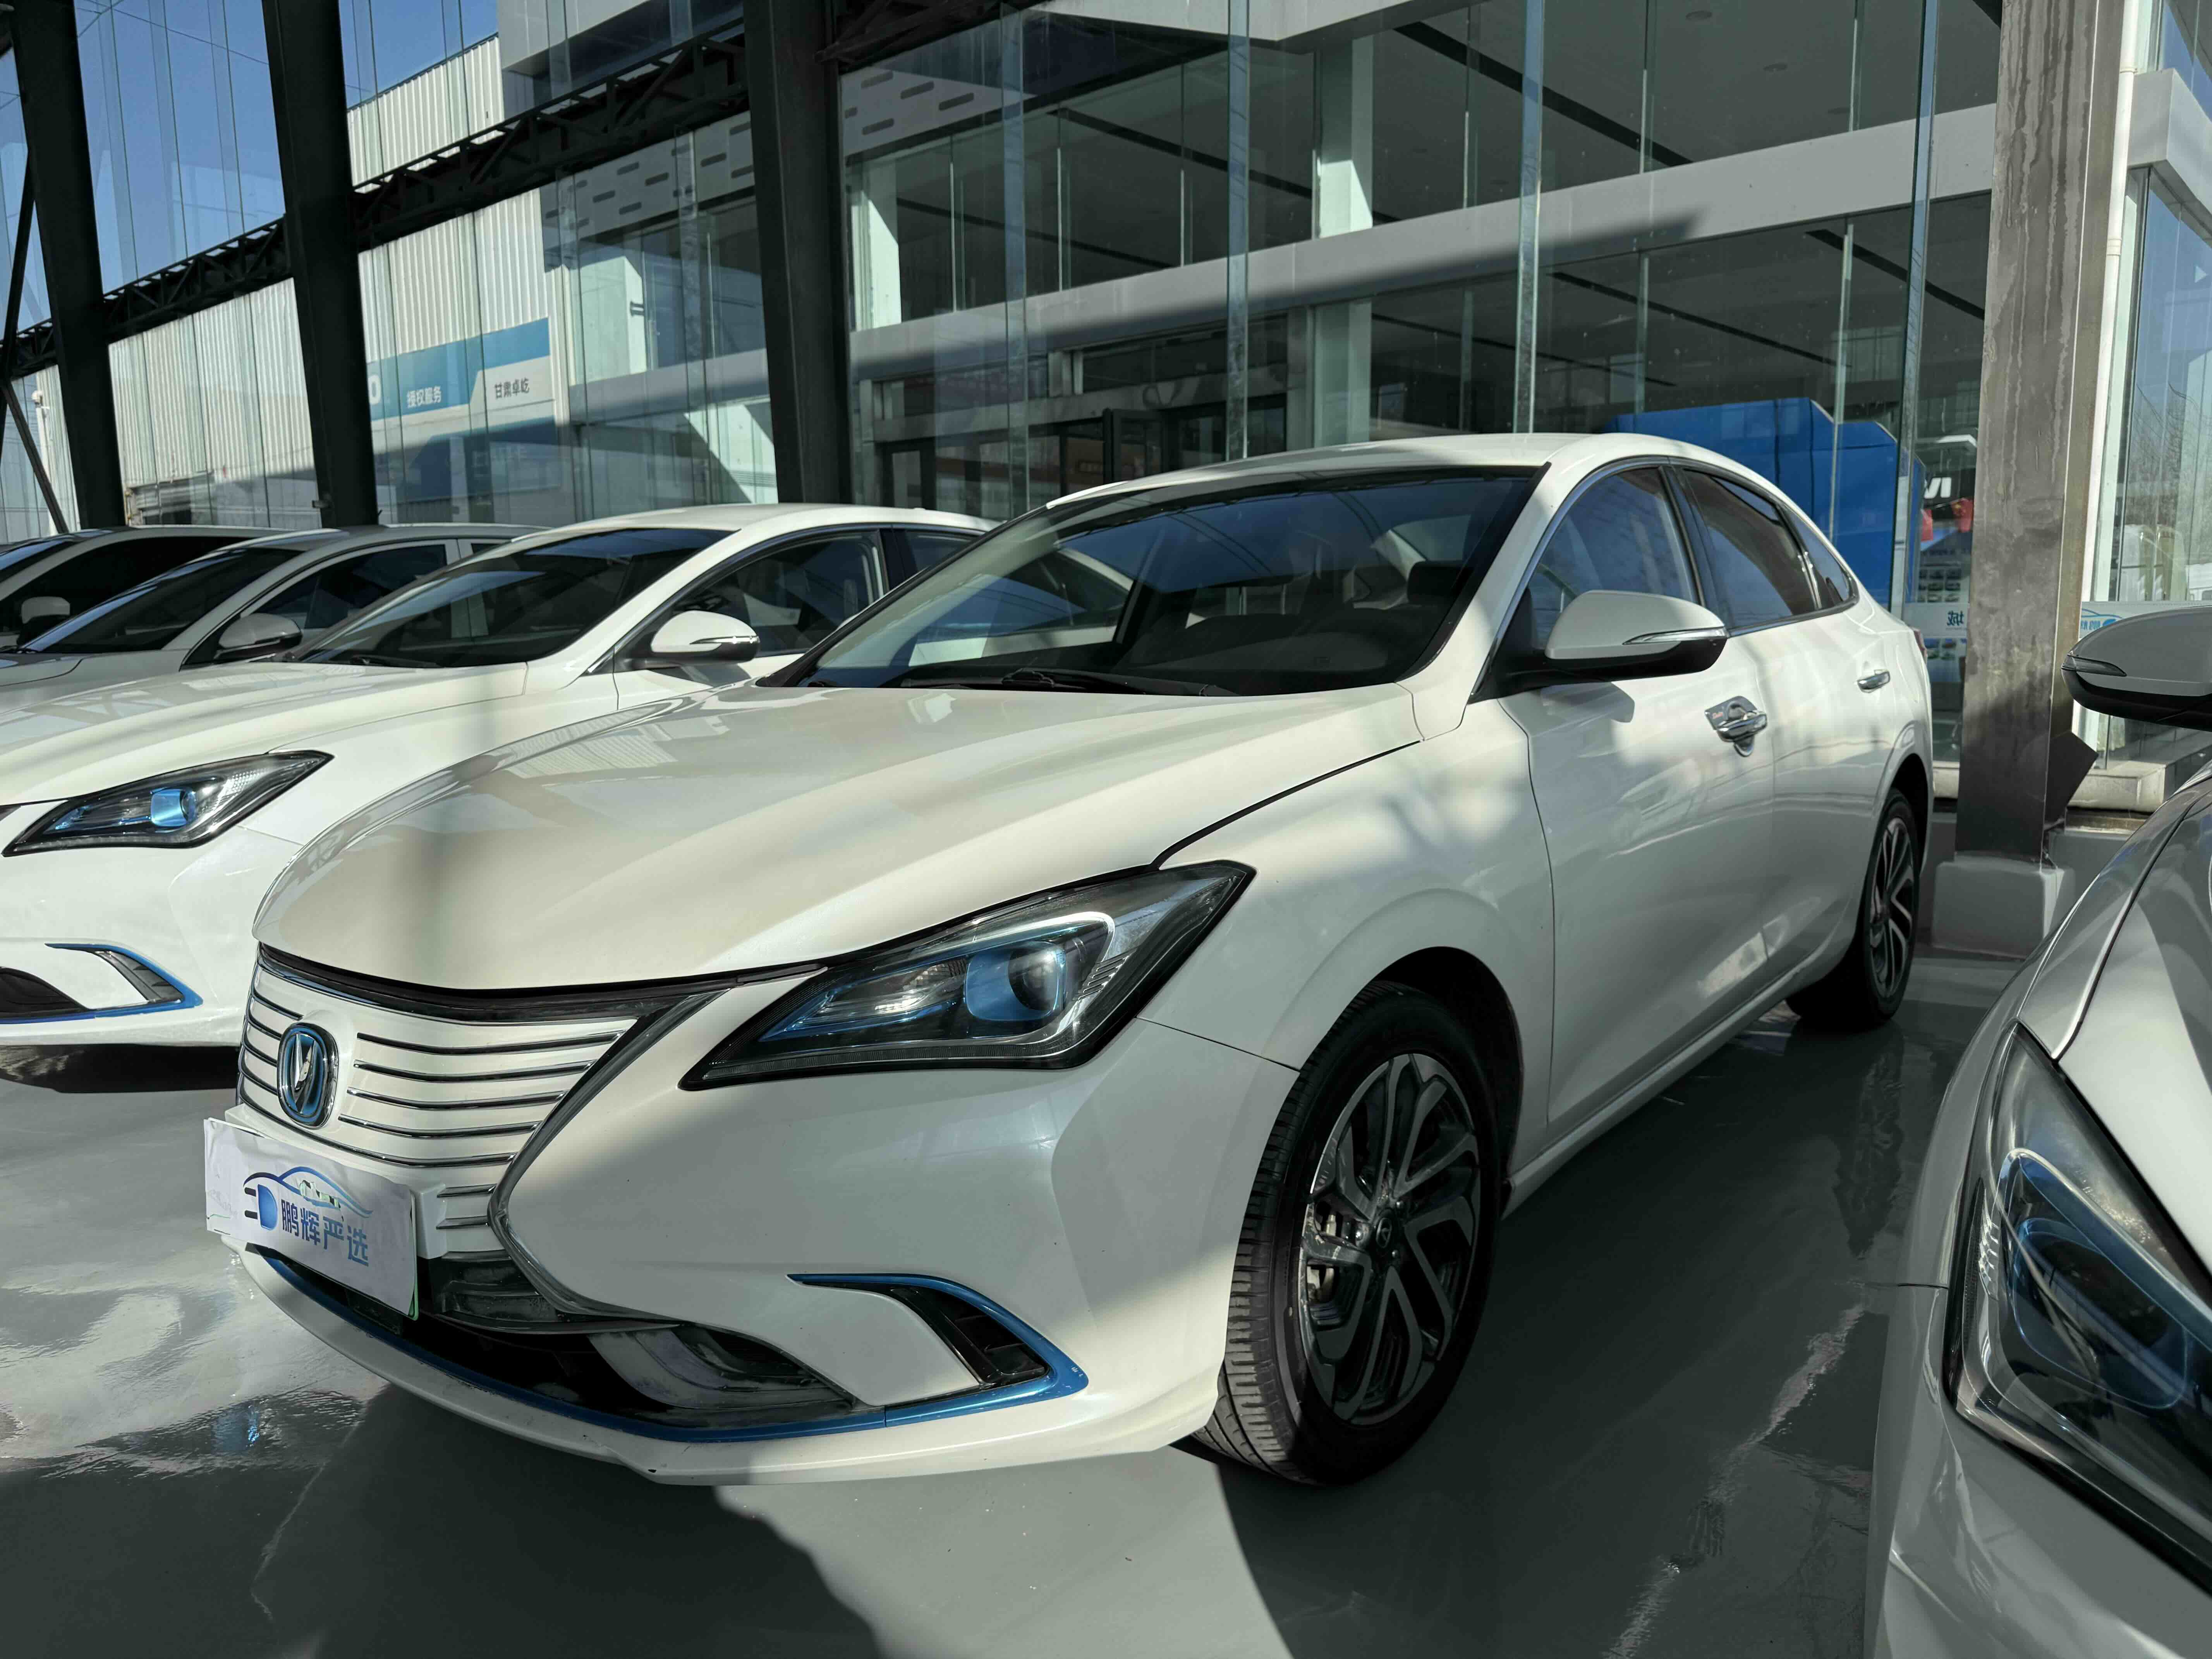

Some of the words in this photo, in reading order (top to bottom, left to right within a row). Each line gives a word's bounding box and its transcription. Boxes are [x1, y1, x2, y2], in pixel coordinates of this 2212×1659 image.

[407, 386, 441, 408] 授权服务
[495, 378, 530, 400] 甘肃卓屹
[281, 1199, 369, 1267] 鹏辉严选
